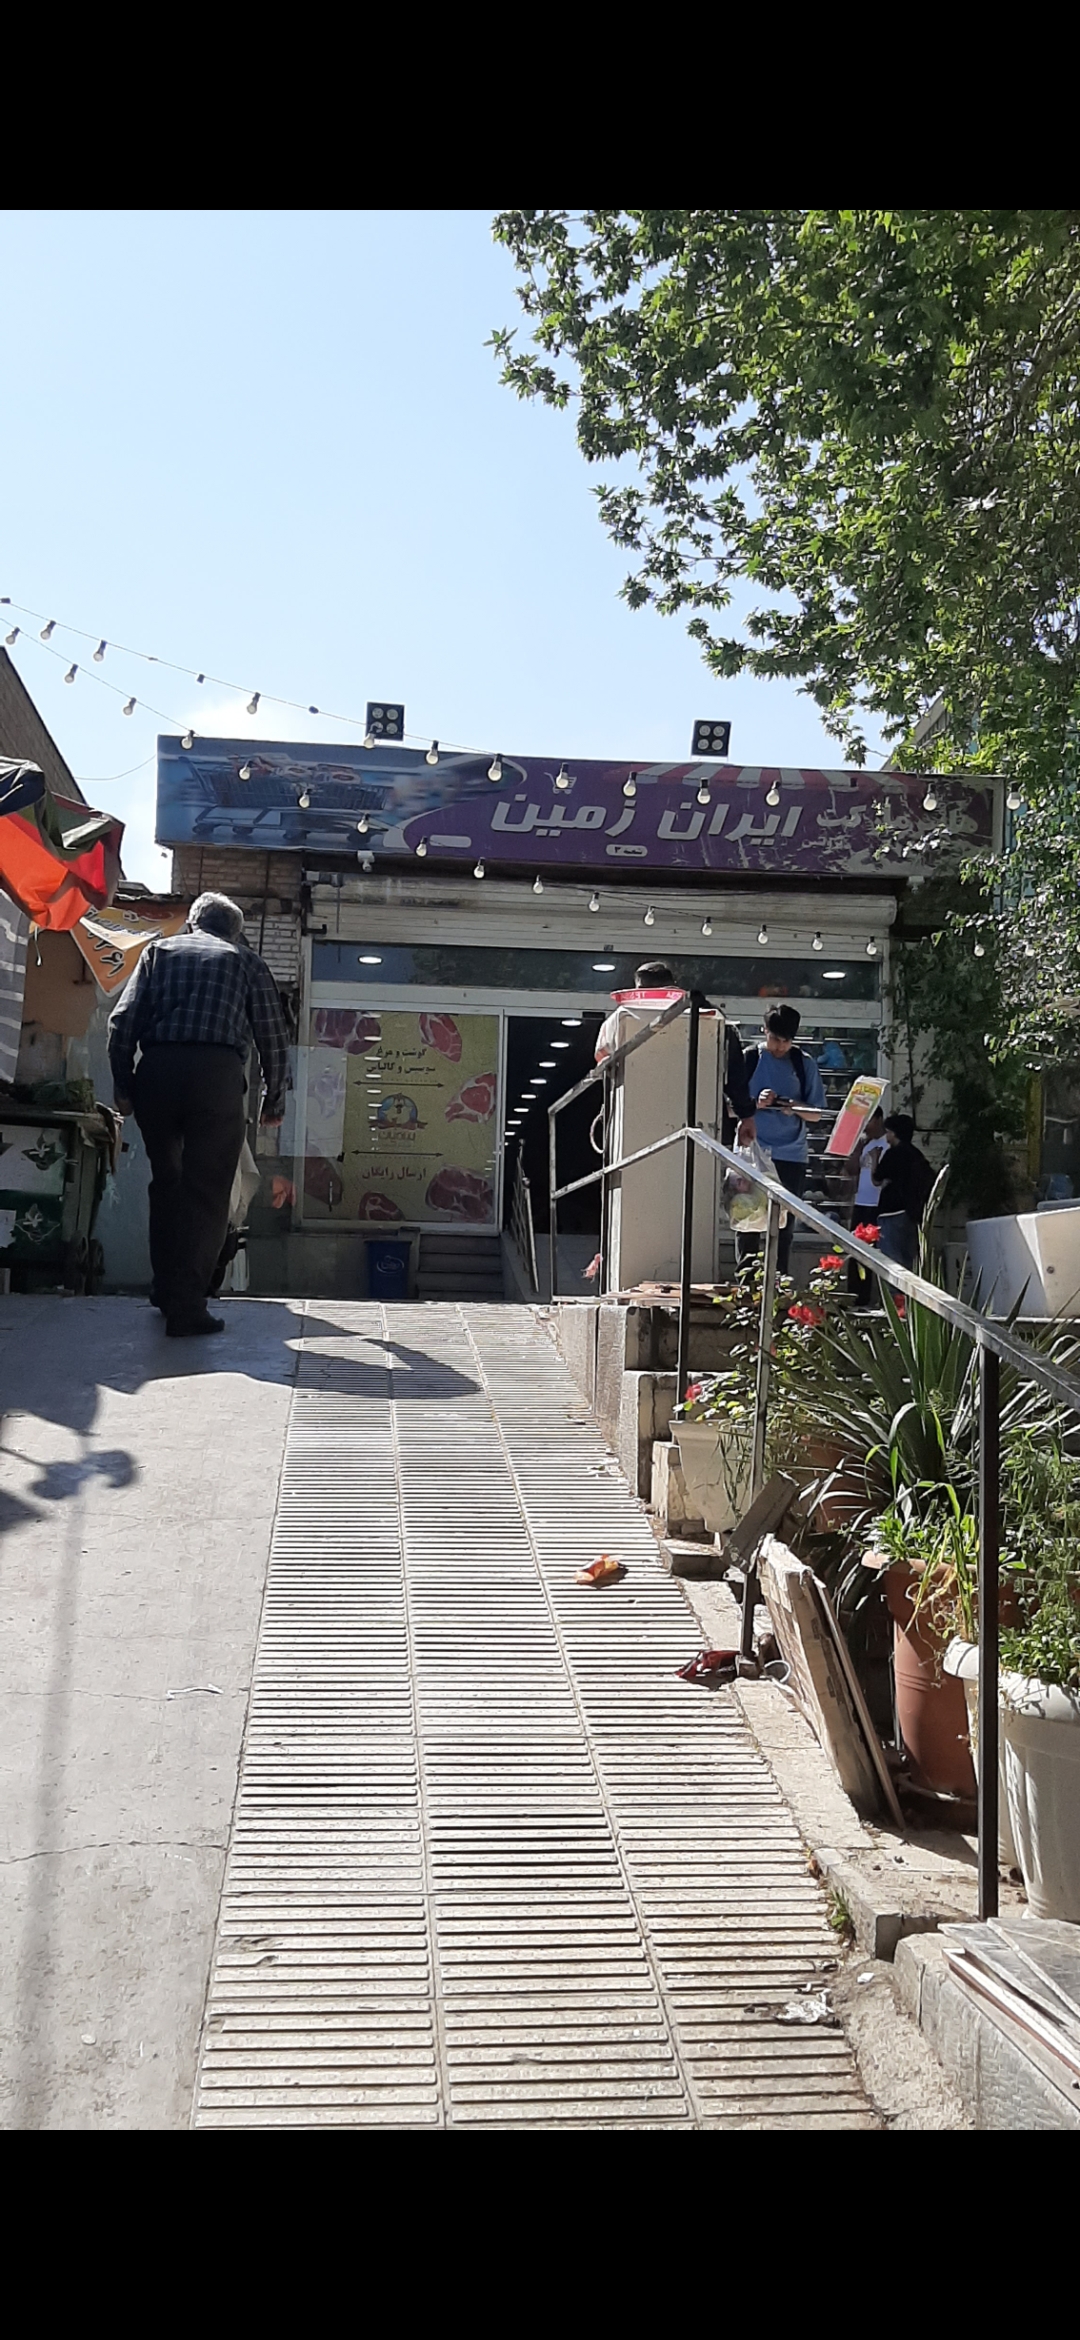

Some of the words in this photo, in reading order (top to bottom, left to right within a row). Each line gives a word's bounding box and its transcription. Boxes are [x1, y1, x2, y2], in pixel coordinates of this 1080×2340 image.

[490, 793, 637, 838] زمین
[656, 801, 805, 846] ایران
[375, 1045, 393, 1058] مرغ
[395, 1050, 400, 1058] و
[401, 1047, 427, 1059] گوشت
[366, 1061, 395, 1073] کالباس
[396, 1065, 402, 1074] و
[404, 1065, 436, 1075] سوسیس
[361, 1166, 395, 1180] رایگان
[396, 1166, 427, 1181] ارسال
